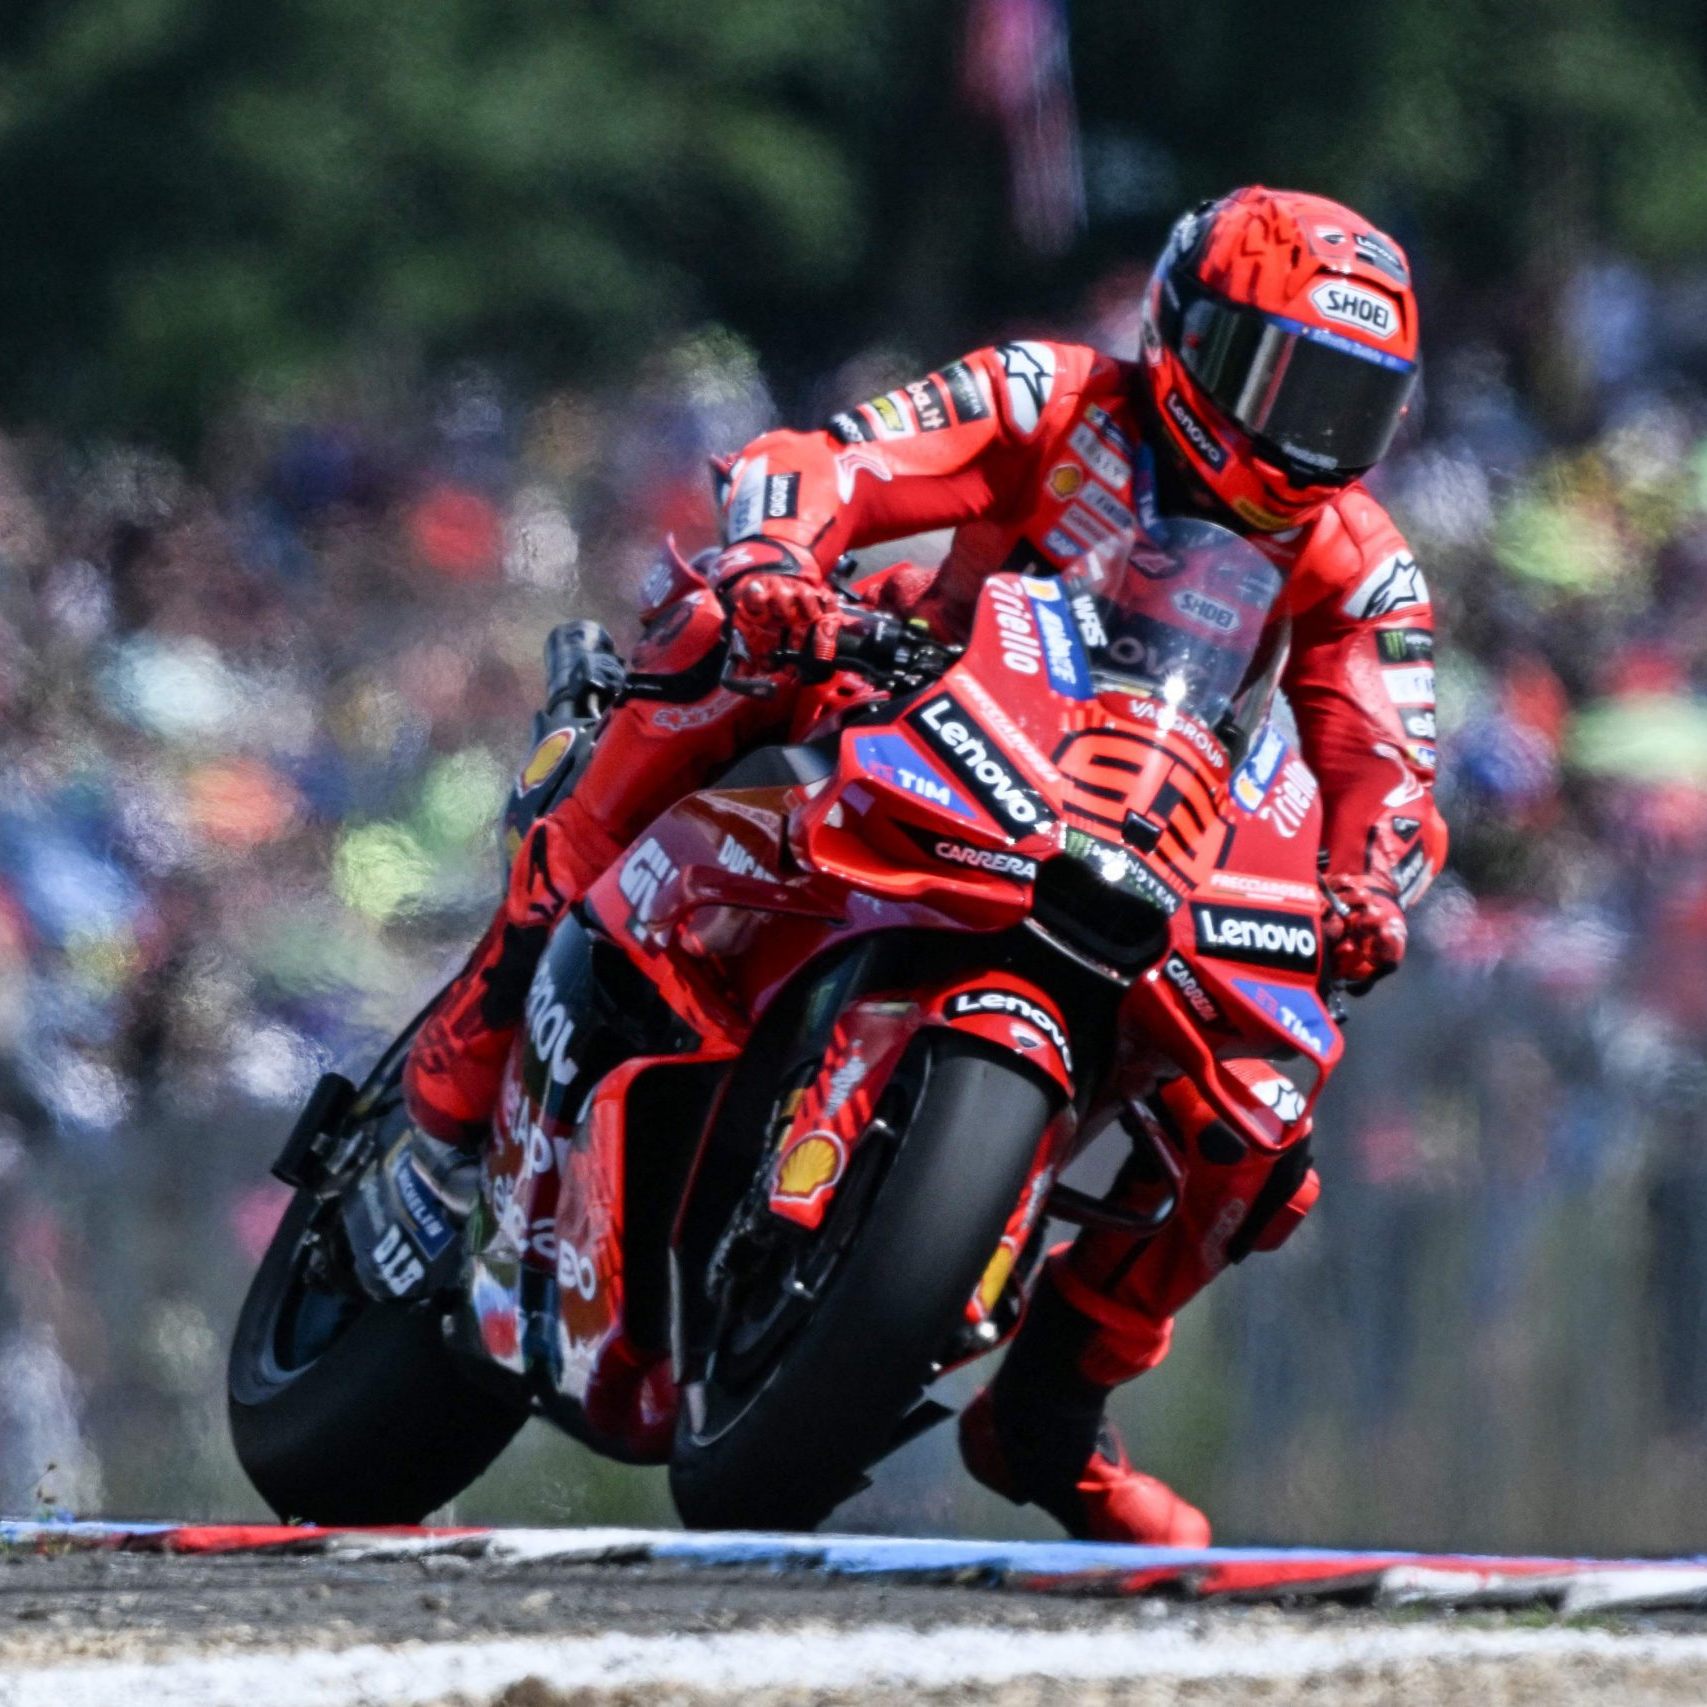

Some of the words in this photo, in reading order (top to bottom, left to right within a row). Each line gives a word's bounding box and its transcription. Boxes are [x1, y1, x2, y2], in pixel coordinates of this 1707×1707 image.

[1326, 290, 1389, 329] SHOEI
[1167, 393, 1221, 462] Lenovo
[919, 700, 1037, 823] Lenovo
[898, 768, 950, 806] TIM
[1053, 728, 1236, 895] 93
[935, 842, 1036, 880] CARRERA
[1201, 910, 1316, 956] Lenovo
